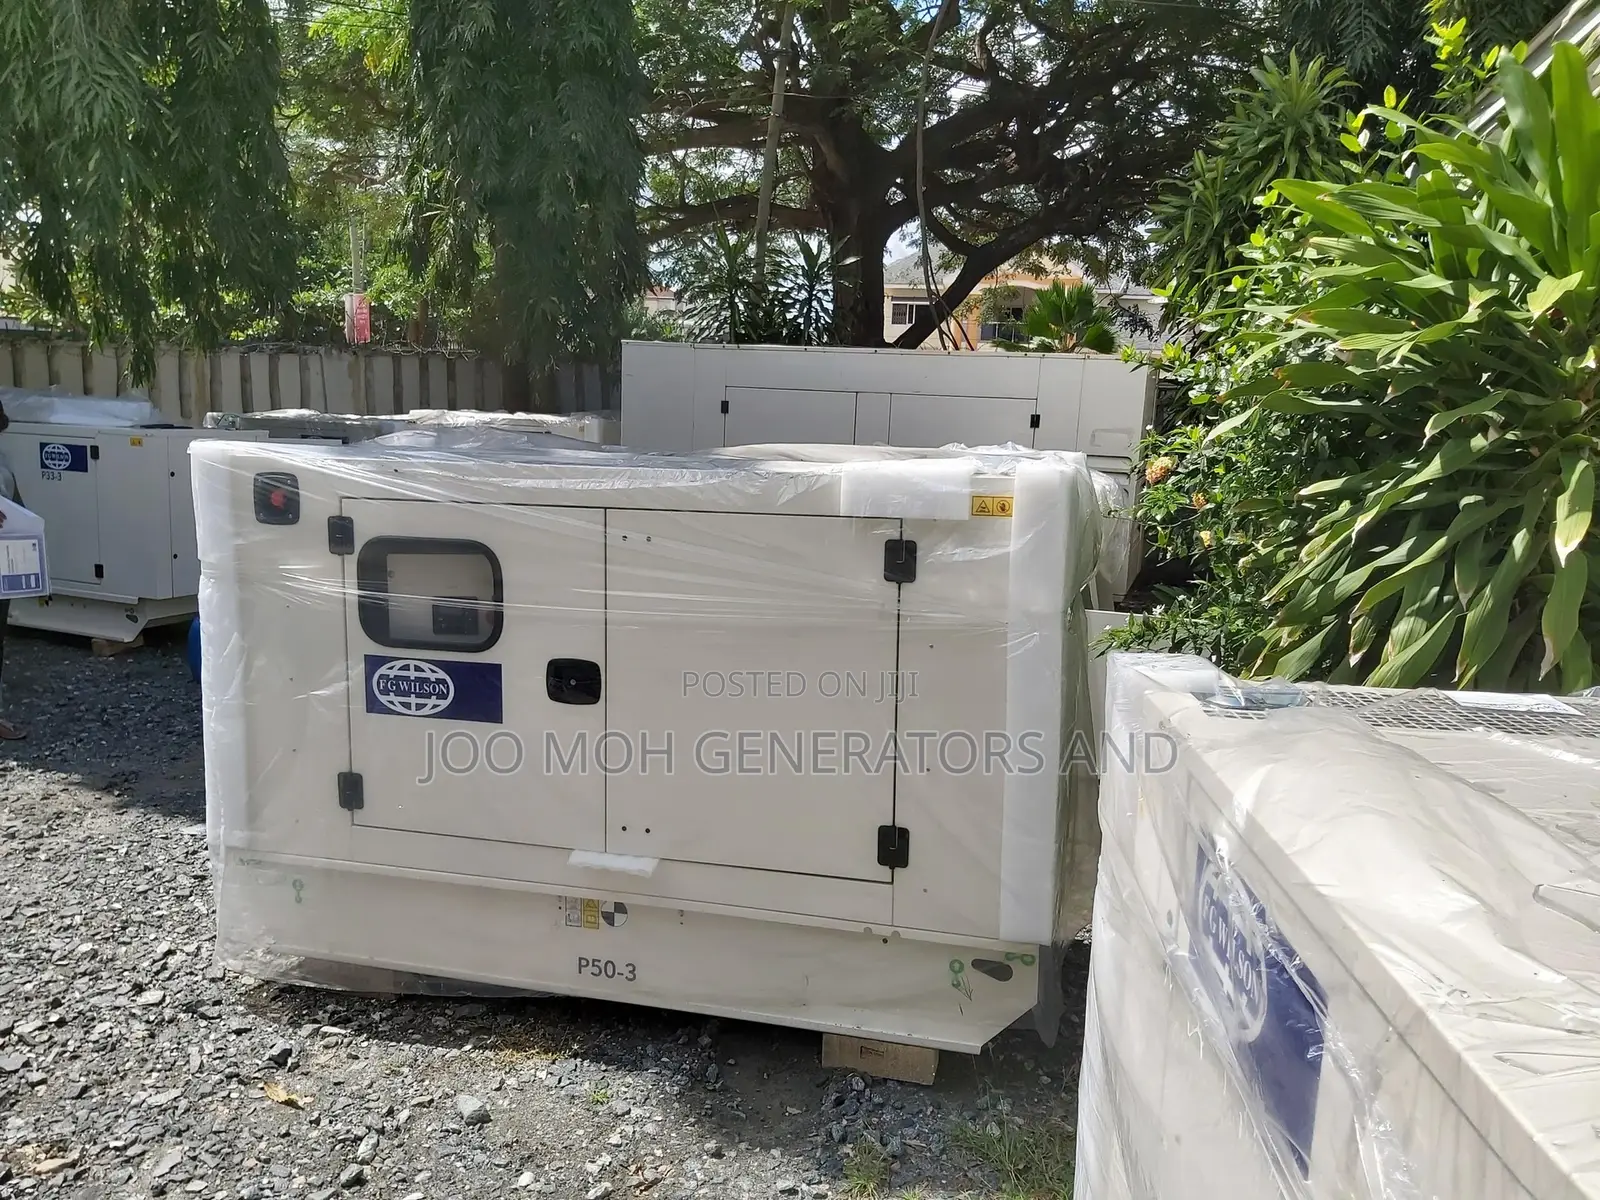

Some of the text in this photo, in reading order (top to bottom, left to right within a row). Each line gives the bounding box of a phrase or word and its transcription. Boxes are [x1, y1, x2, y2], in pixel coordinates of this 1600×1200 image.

[41, 471, 62, 481] P33-3
[379, 679, 447, 695] FG WILSON
[578, 956, 637, 982] P50-3
